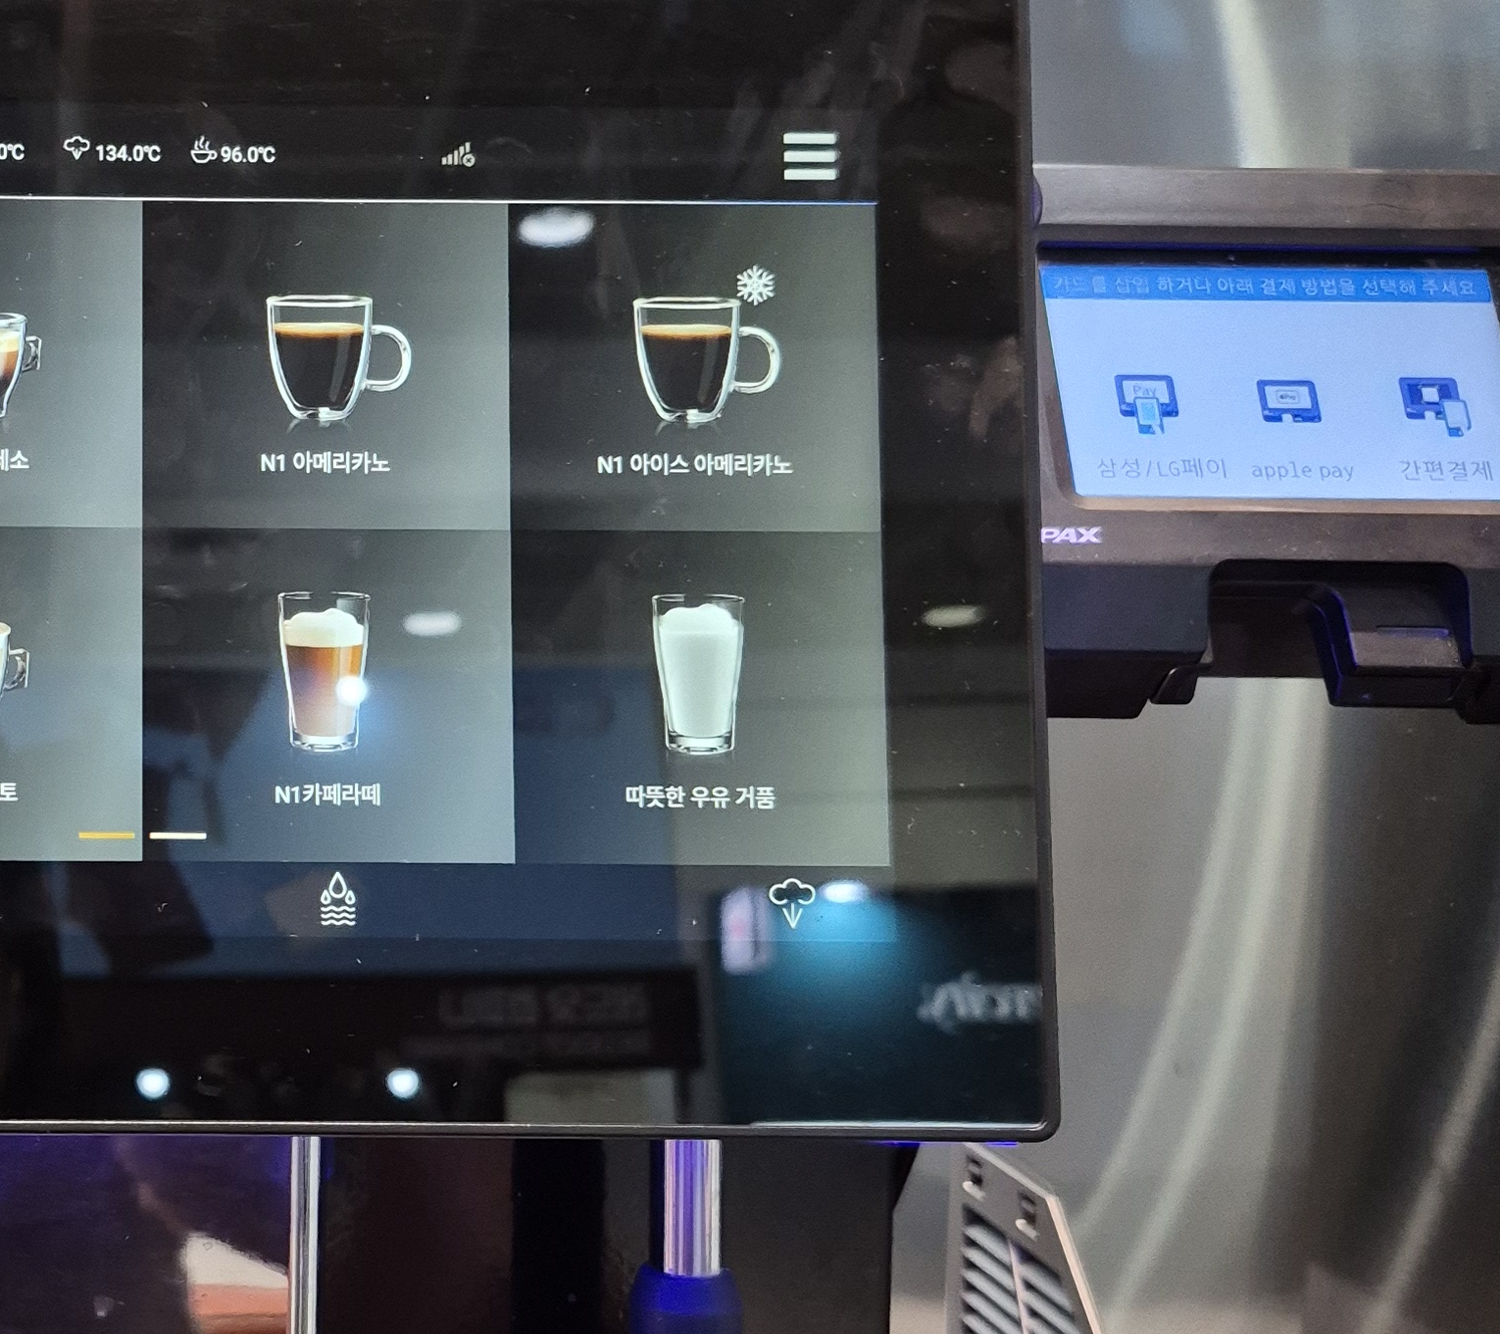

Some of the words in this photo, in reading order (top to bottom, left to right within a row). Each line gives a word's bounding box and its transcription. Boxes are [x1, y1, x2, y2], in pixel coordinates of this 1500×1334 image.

[1157, 277, 1211, 294] 하거나
[1217, 277, 1254, 295] 아래
[1260, 278, 1296, 296] 결제
[1301, 278, 1355, 296] 방법을
[1362, 278, 1416, 297] 선택해
[1422, 278, 1476, 297] 주세요
[261, 453, 286, 472] N1
[293, 450, 391, 474] 아메리카노
[598, 455, 623, 474] N1
[630, 453, 690, 475] 아이스
[695, 453, 793, 476] 아메리카노
[1100, 458, 1227, 479] 삼성/LG페이
[1252, 461, 1312, 481] apple
[1320, 464, 1354, 482] pay
[1399, 460, 1494, 481] 간편결제
[1041, 527, 1102, 543] PAX
[274, 783, 381, 807] N1카페라떼
[625, 784, 686, 809] 따뜻한
[690, 786, 730, 810] 우유
[735, 786, 775, 811] 거품
